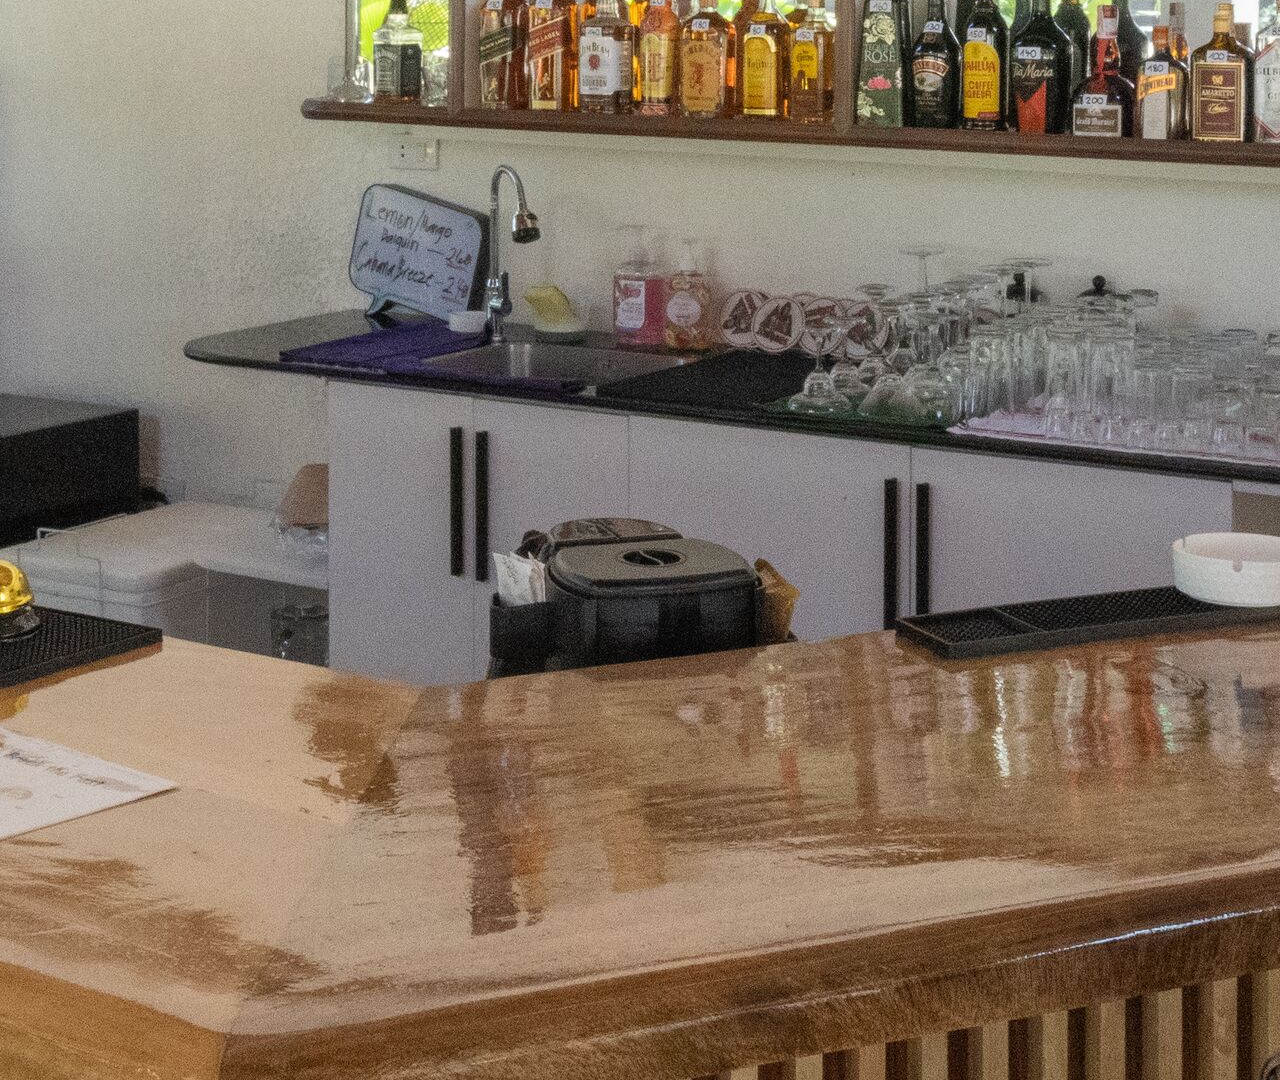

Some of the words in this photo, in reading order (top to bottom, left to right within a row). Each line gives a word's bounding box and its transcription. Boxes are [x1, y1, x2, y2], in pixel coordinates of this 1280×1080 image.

[864, 51, 896, 64] ROSE
[965, 57, 996, 73] AHLÚA
[1023, 62, 1054, 78] Maria
[1086, 97, 1104, 105] 200
